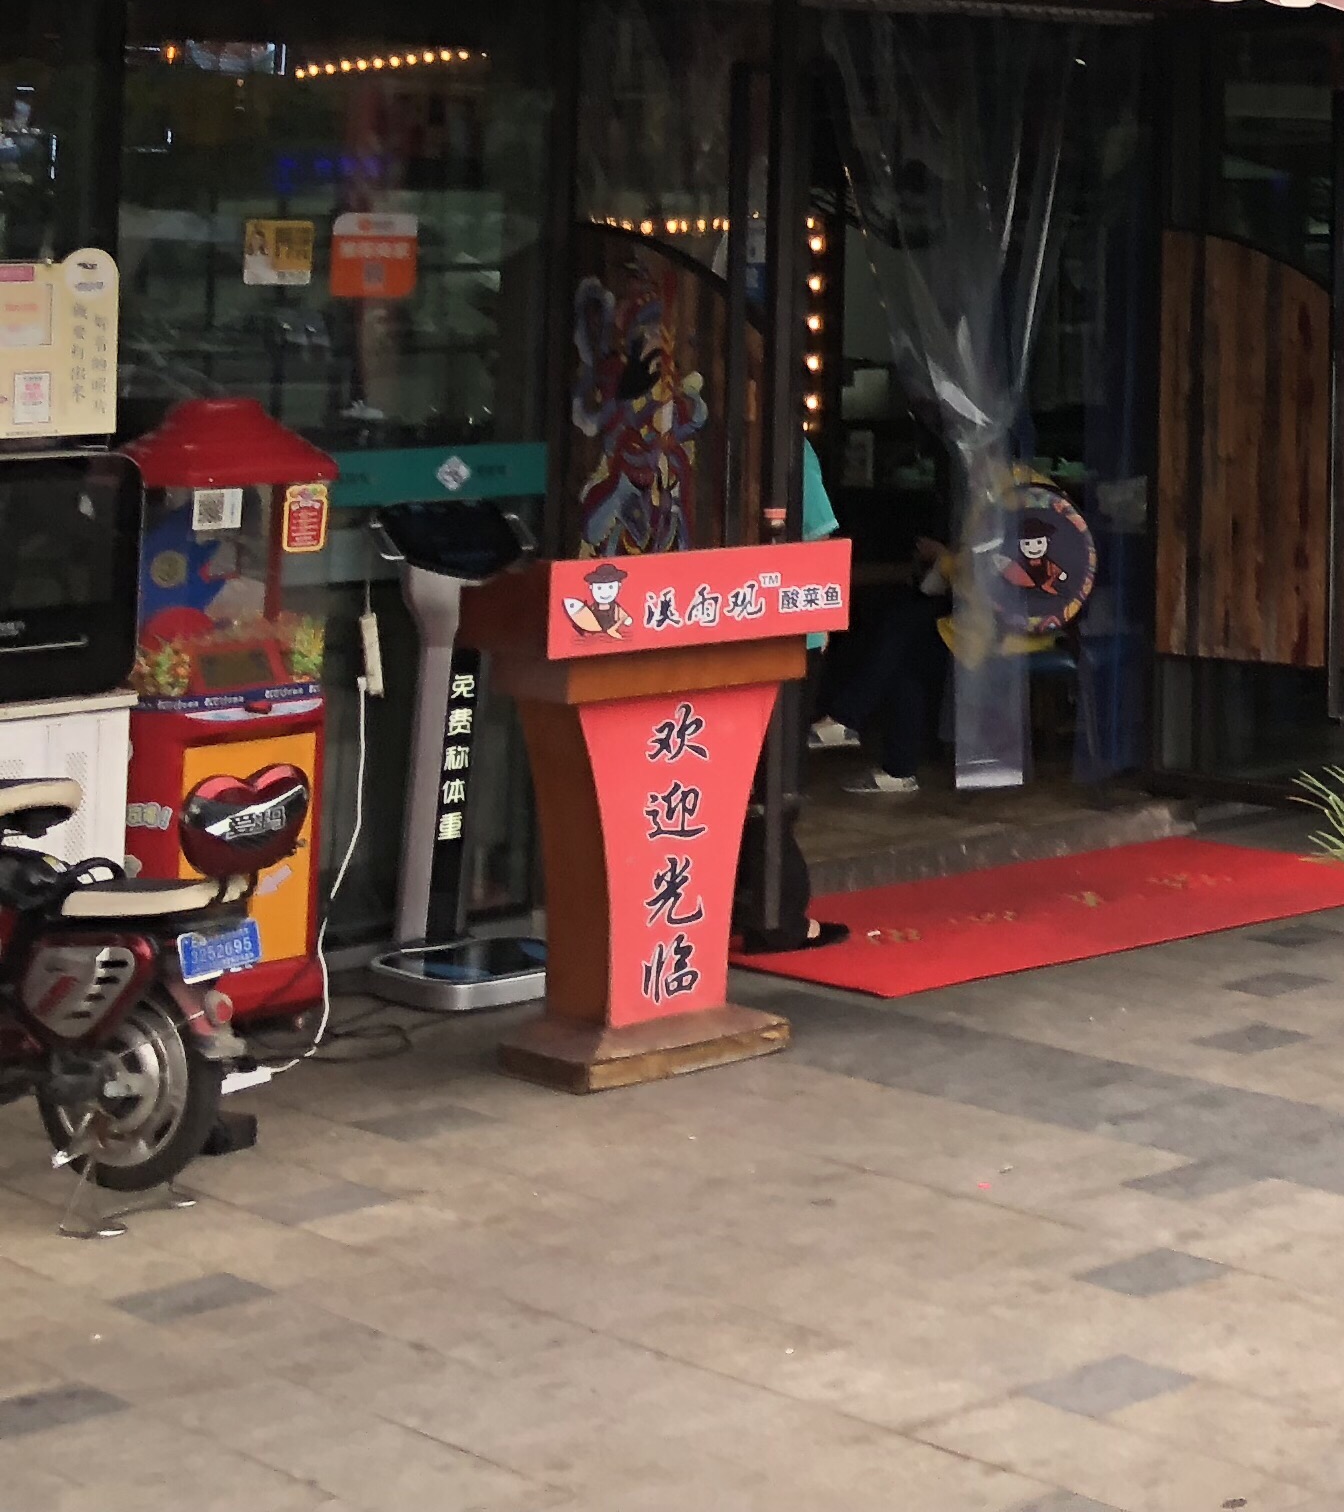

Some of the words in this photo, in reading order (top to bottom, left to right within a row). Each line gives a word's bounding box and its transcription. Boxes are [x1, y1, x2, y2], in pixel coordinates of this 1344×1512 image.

[646, 584, 763, 627] 溪雨观
[781, 586, 842, 610] 酸菜鱼
[438, 674, 476, 841] 免费称体重
[643, 702, 709, 1004] 欢迎光临
